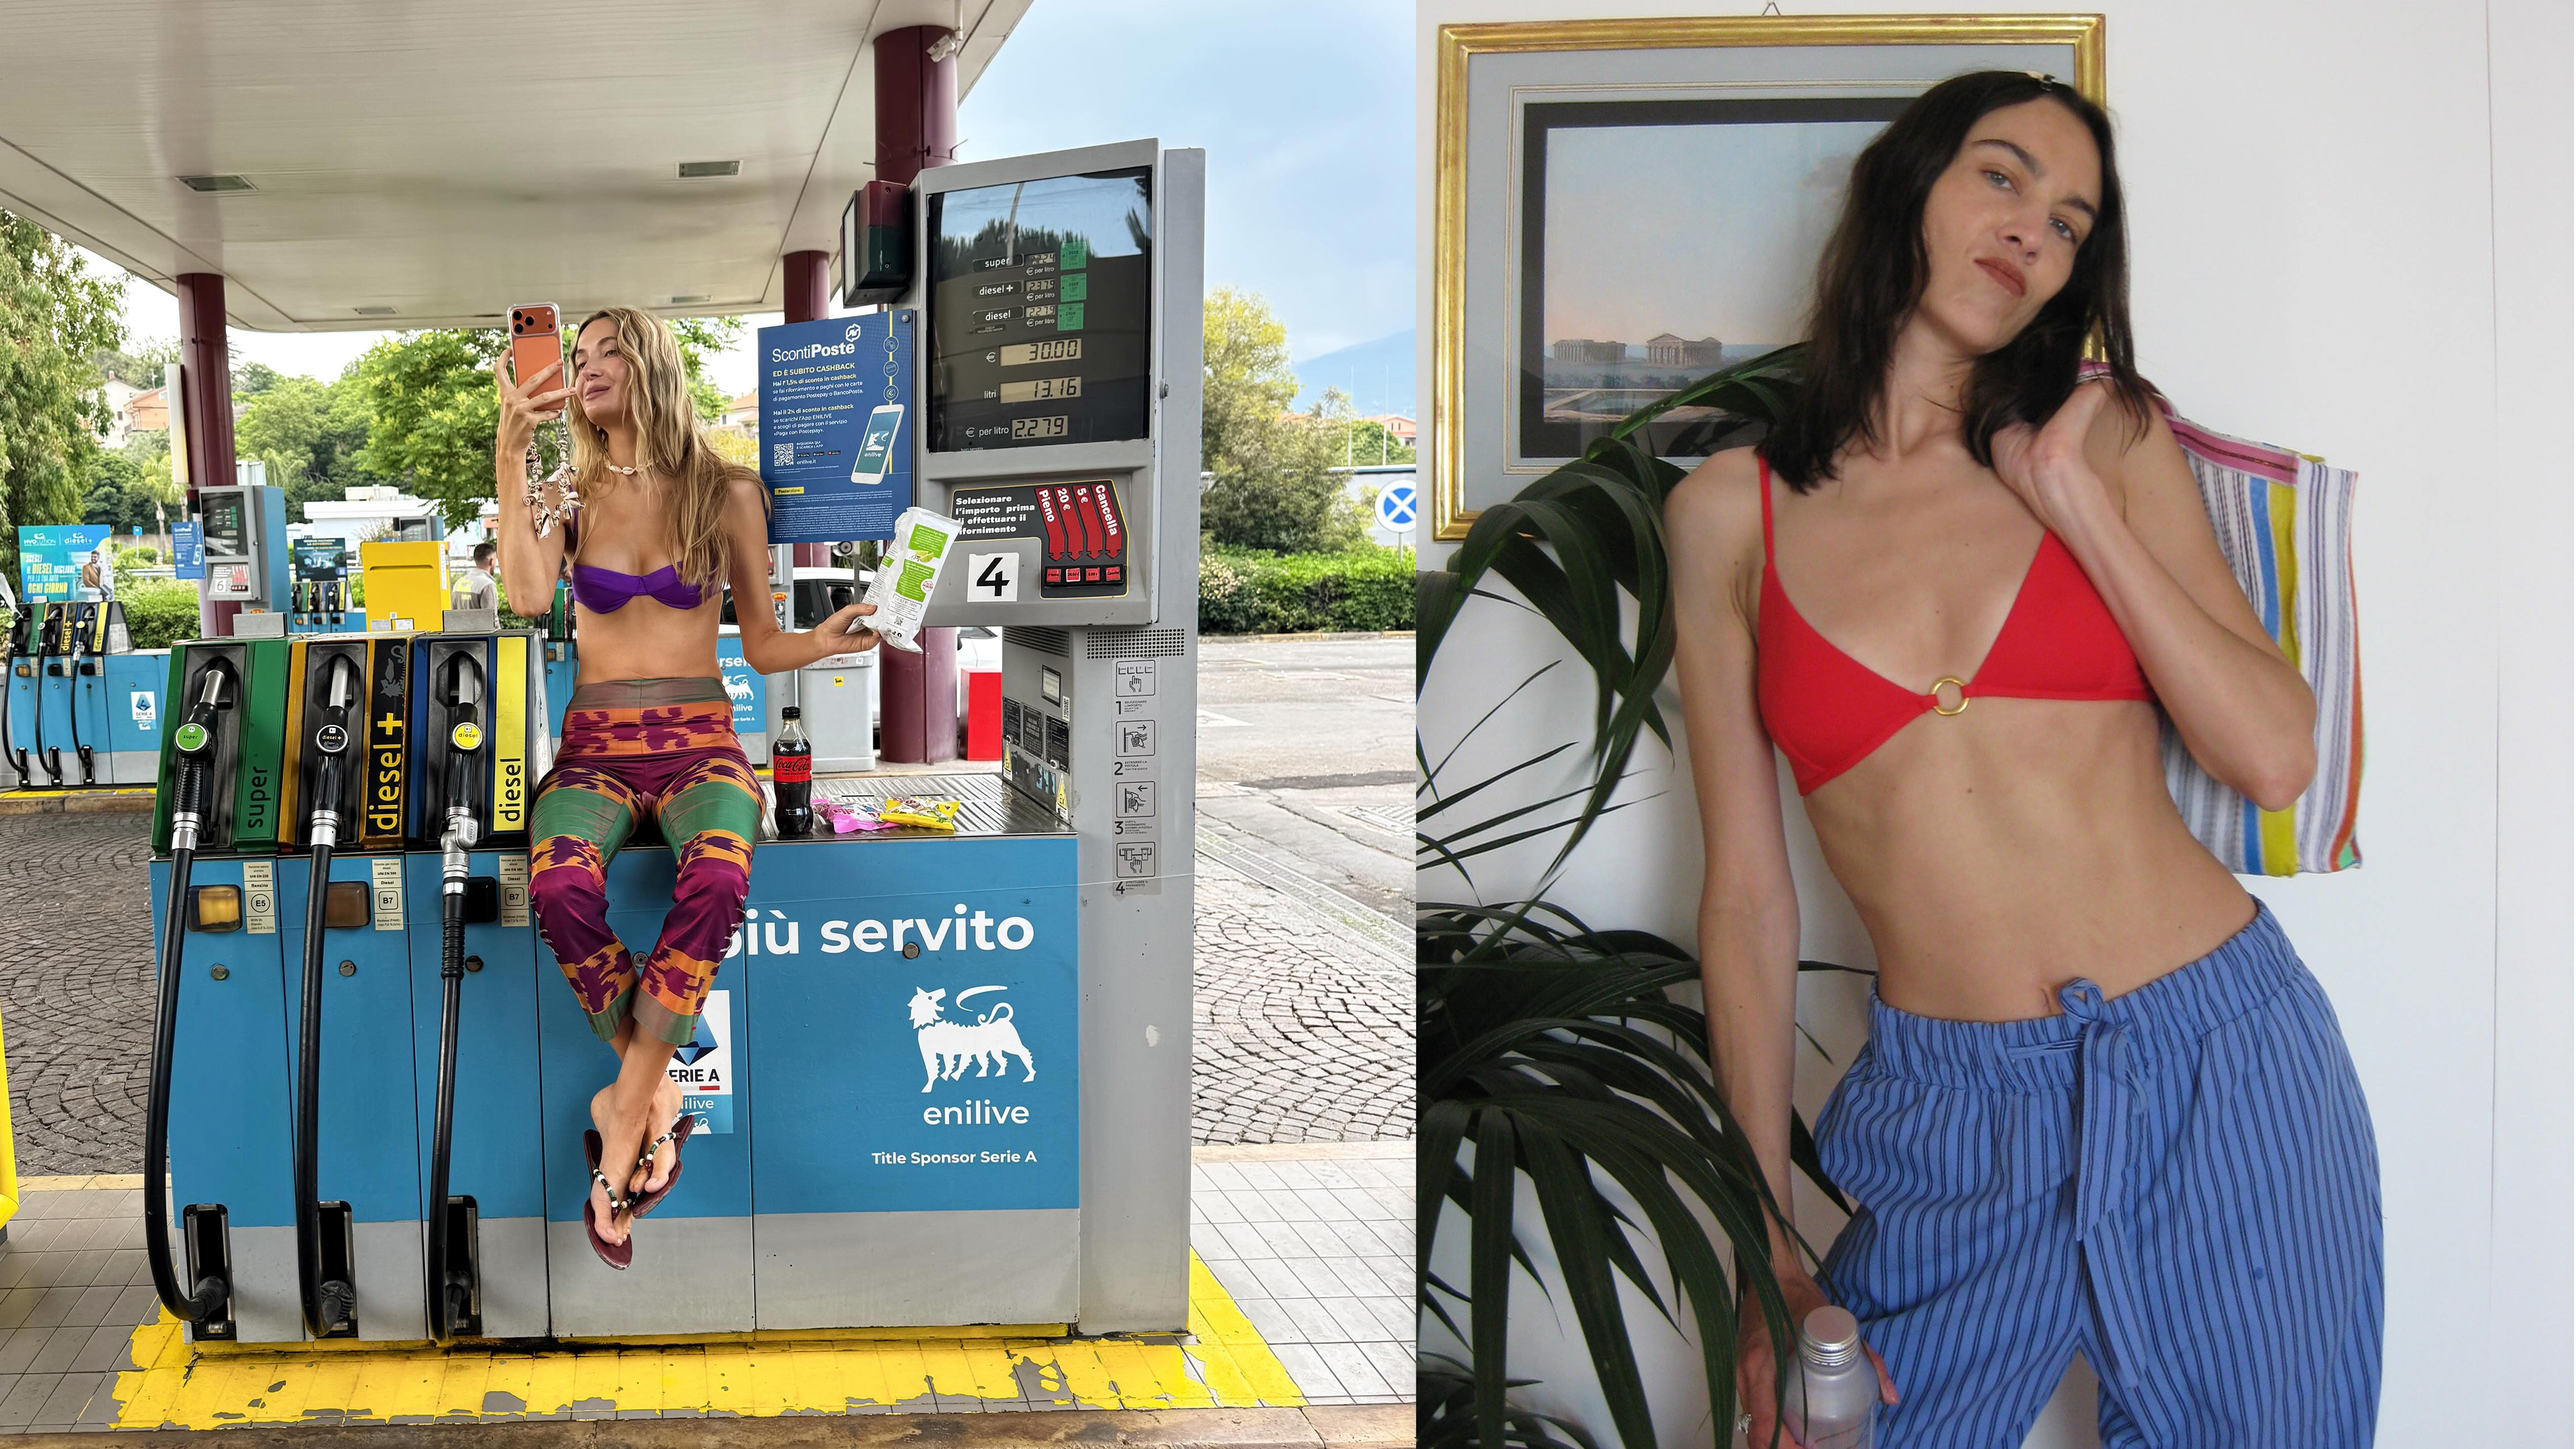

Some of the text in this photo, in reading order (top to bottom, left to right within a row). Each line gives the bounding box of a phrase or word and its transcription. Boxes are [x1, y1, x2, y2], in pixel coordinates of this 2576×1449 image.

[985, 258, 1009, 268] super
[1027, 293, 1034, 301] €
[985, 310, 1010, 321] diesel
[1027, 319, 1034, 327] €
[772, 342, 855, 362] ScontiPoste
[986, 339, 1078, 363] € 30.00
[790, 367, 815, 375] SUBITO
[817, 363, 855, 372] CASHBACK
[984, 378, 1077, 399] litri 13.16
[966, 417, 1065, 438] € per litro 2.279
[1057, 488, 1068, 503] 20
[1077, 488, 1087, 496] 5
[956, 496, 1012, 505] Selezionare
[1038, 489, 1055, 522] Pieno
[956, 504, 1035, 515] l'importo prima
[1095, 484, 1117, 536] Cancella
[967, 516, 1016, 524] effettuare
[26, 554, 43, 563] SCEGLI
[32, 563, 52, 574] DIESEL
[53, 565, 77, 574] MIGLIORE
[976, 557, 1010, 596] 4
[28, 582, 68, 594] OGNI GIORNO
[217, 580, 224, 591] 6
[1115, 701, 1121, 715] 1
[1114, 761, 1123, 775] 2
[498, 758, 521, 822] diesel
[247, 766, 271, 829] super
[1114, 820, 1124, 835] 3
[1115, 882, 1126, 895] 4
[820, 903, 1034, 954] servito
[708, 1068, 720, 1082] A
[923, 1099, 1030, 1125] enilive
[871, 1150, 1037, 1166] Title Sponsor Serie A
